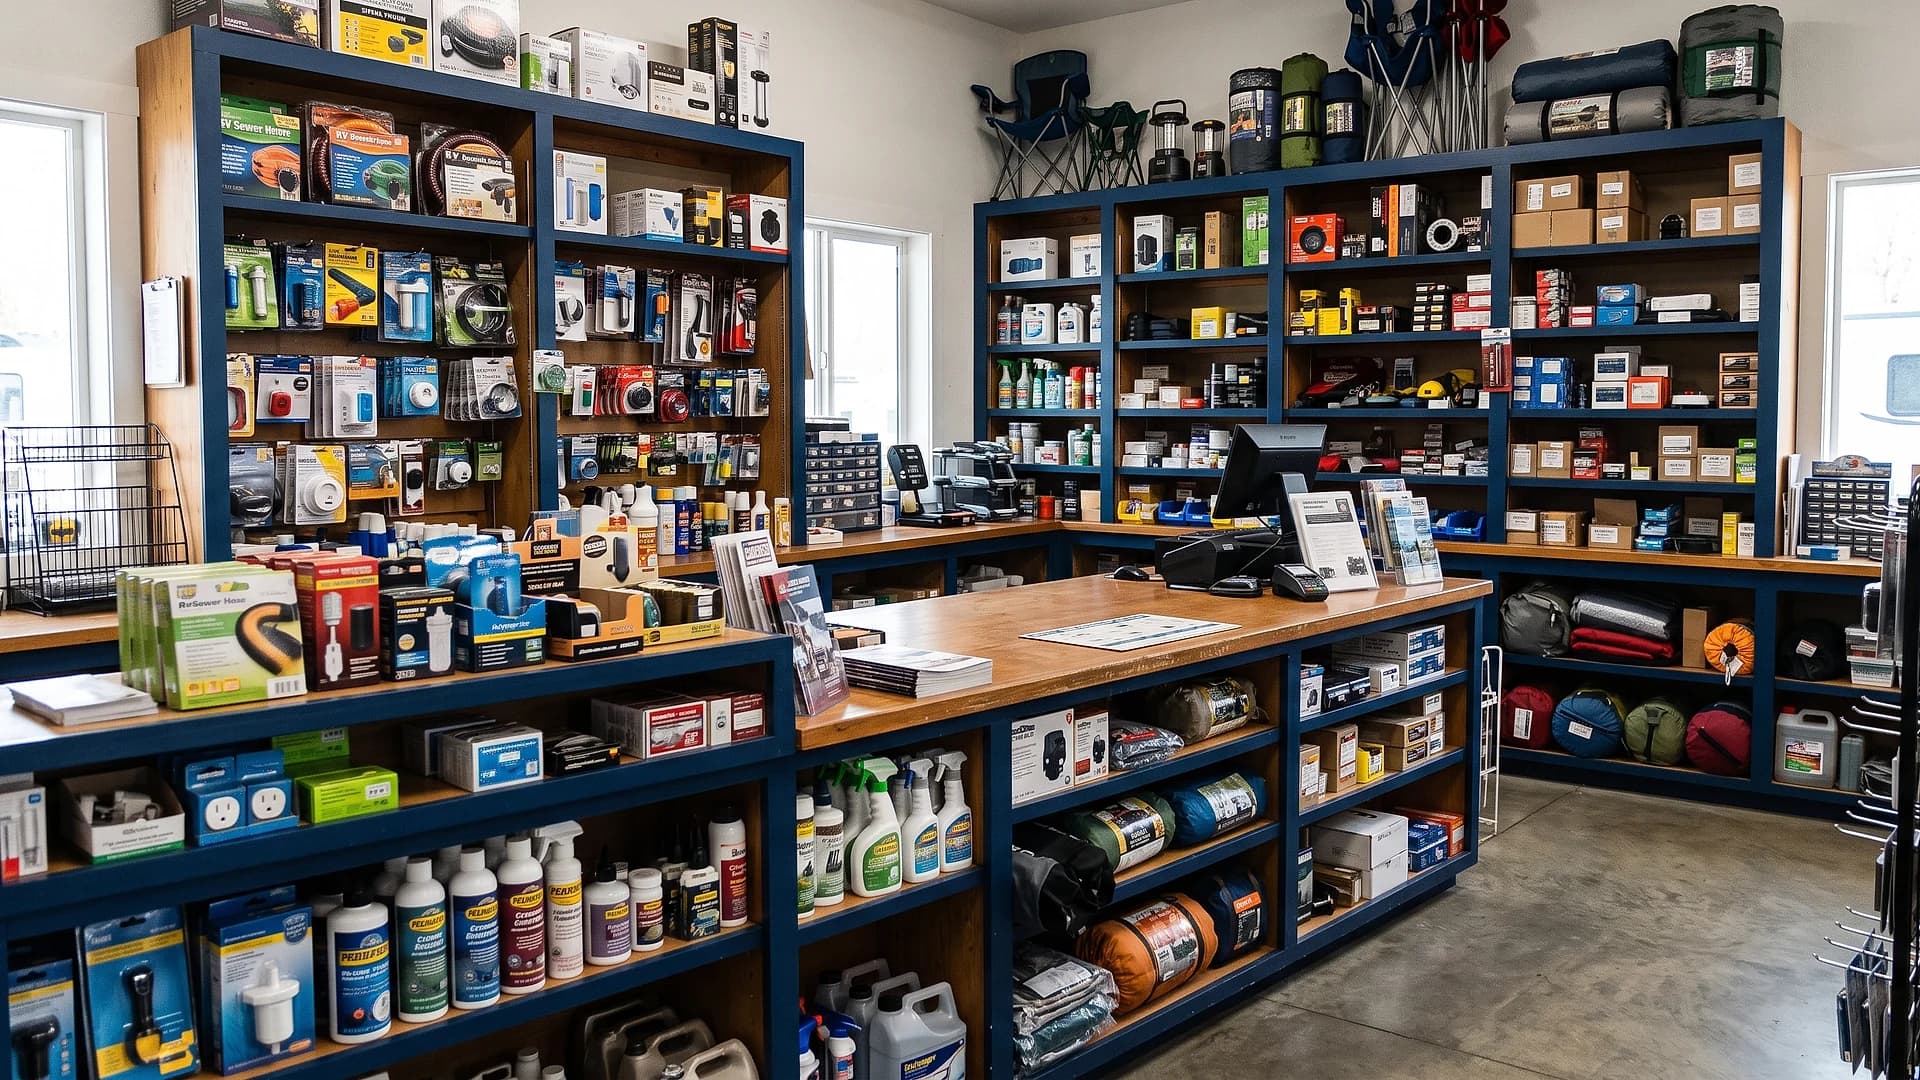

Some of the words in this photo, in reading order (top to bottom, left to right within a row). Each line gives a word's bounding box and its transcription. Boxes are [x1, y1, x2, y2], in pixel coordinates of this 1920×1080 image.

[233, 120, 262, 133] Sewer
[336, 130, 348, 140] RV
[445, 150, 459, 160] RV
